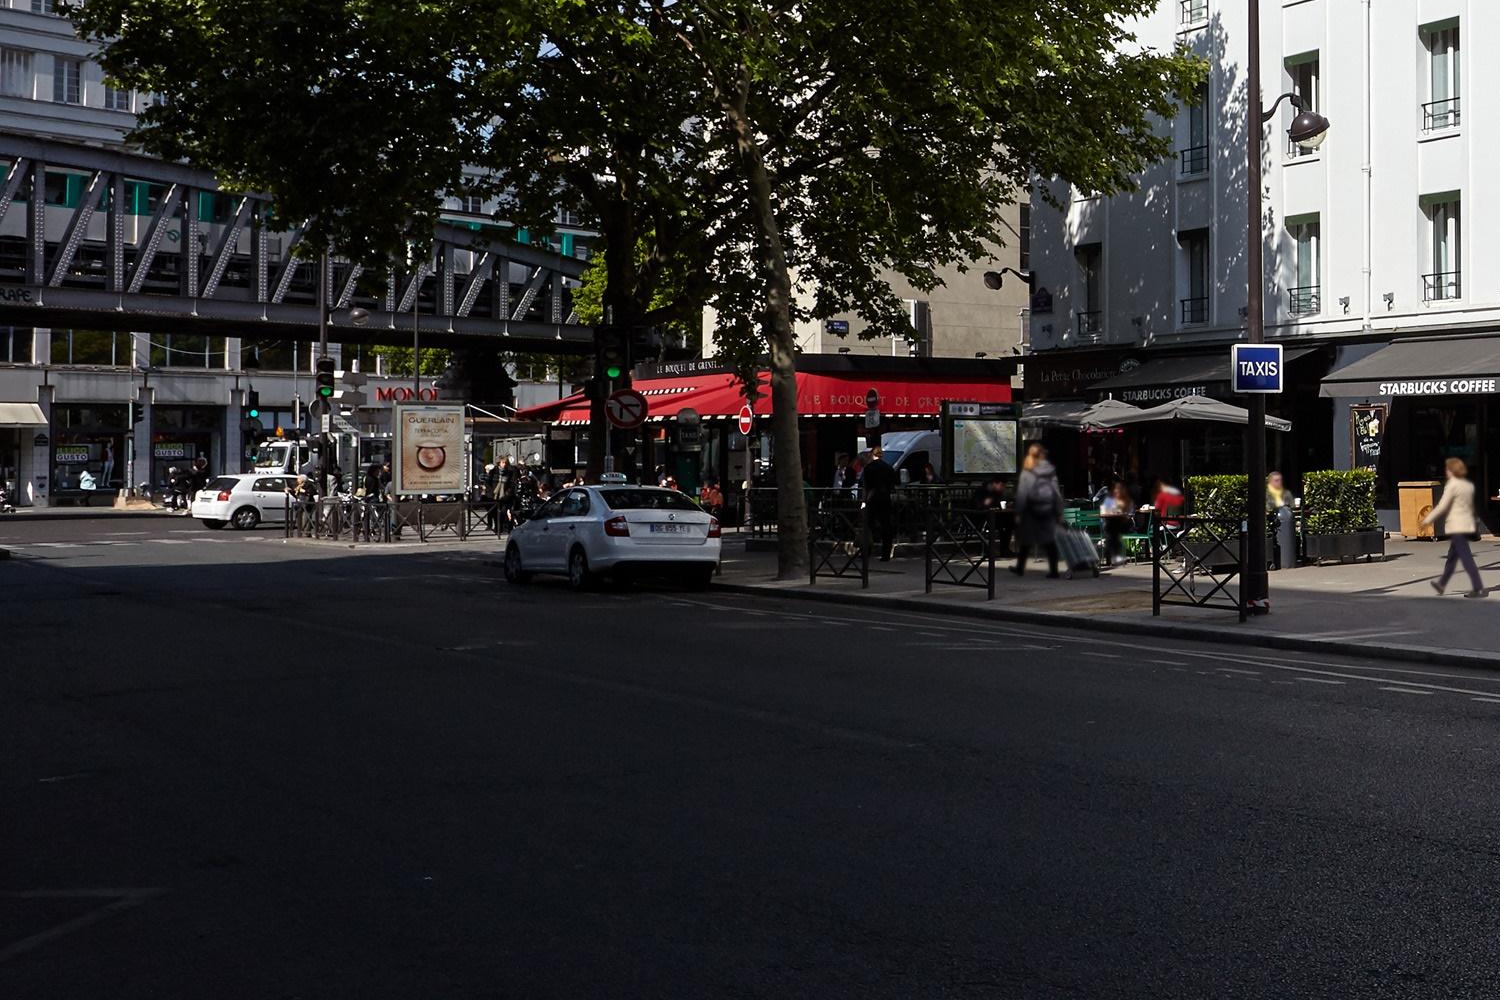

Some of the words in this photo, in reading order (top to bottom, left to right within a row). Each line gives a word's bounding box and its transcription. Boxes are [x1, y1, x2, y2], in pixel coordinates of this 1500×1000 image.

[1239, 361, 1278, 377] TAXIS
[1379, 381, 1448, 395] STARBUCKS
[1450, 379, 1496, 393] COFFEE
[1122, 388, 1172, 401] STARBUCKS
[57, 453, 87, 461] GUSTO
